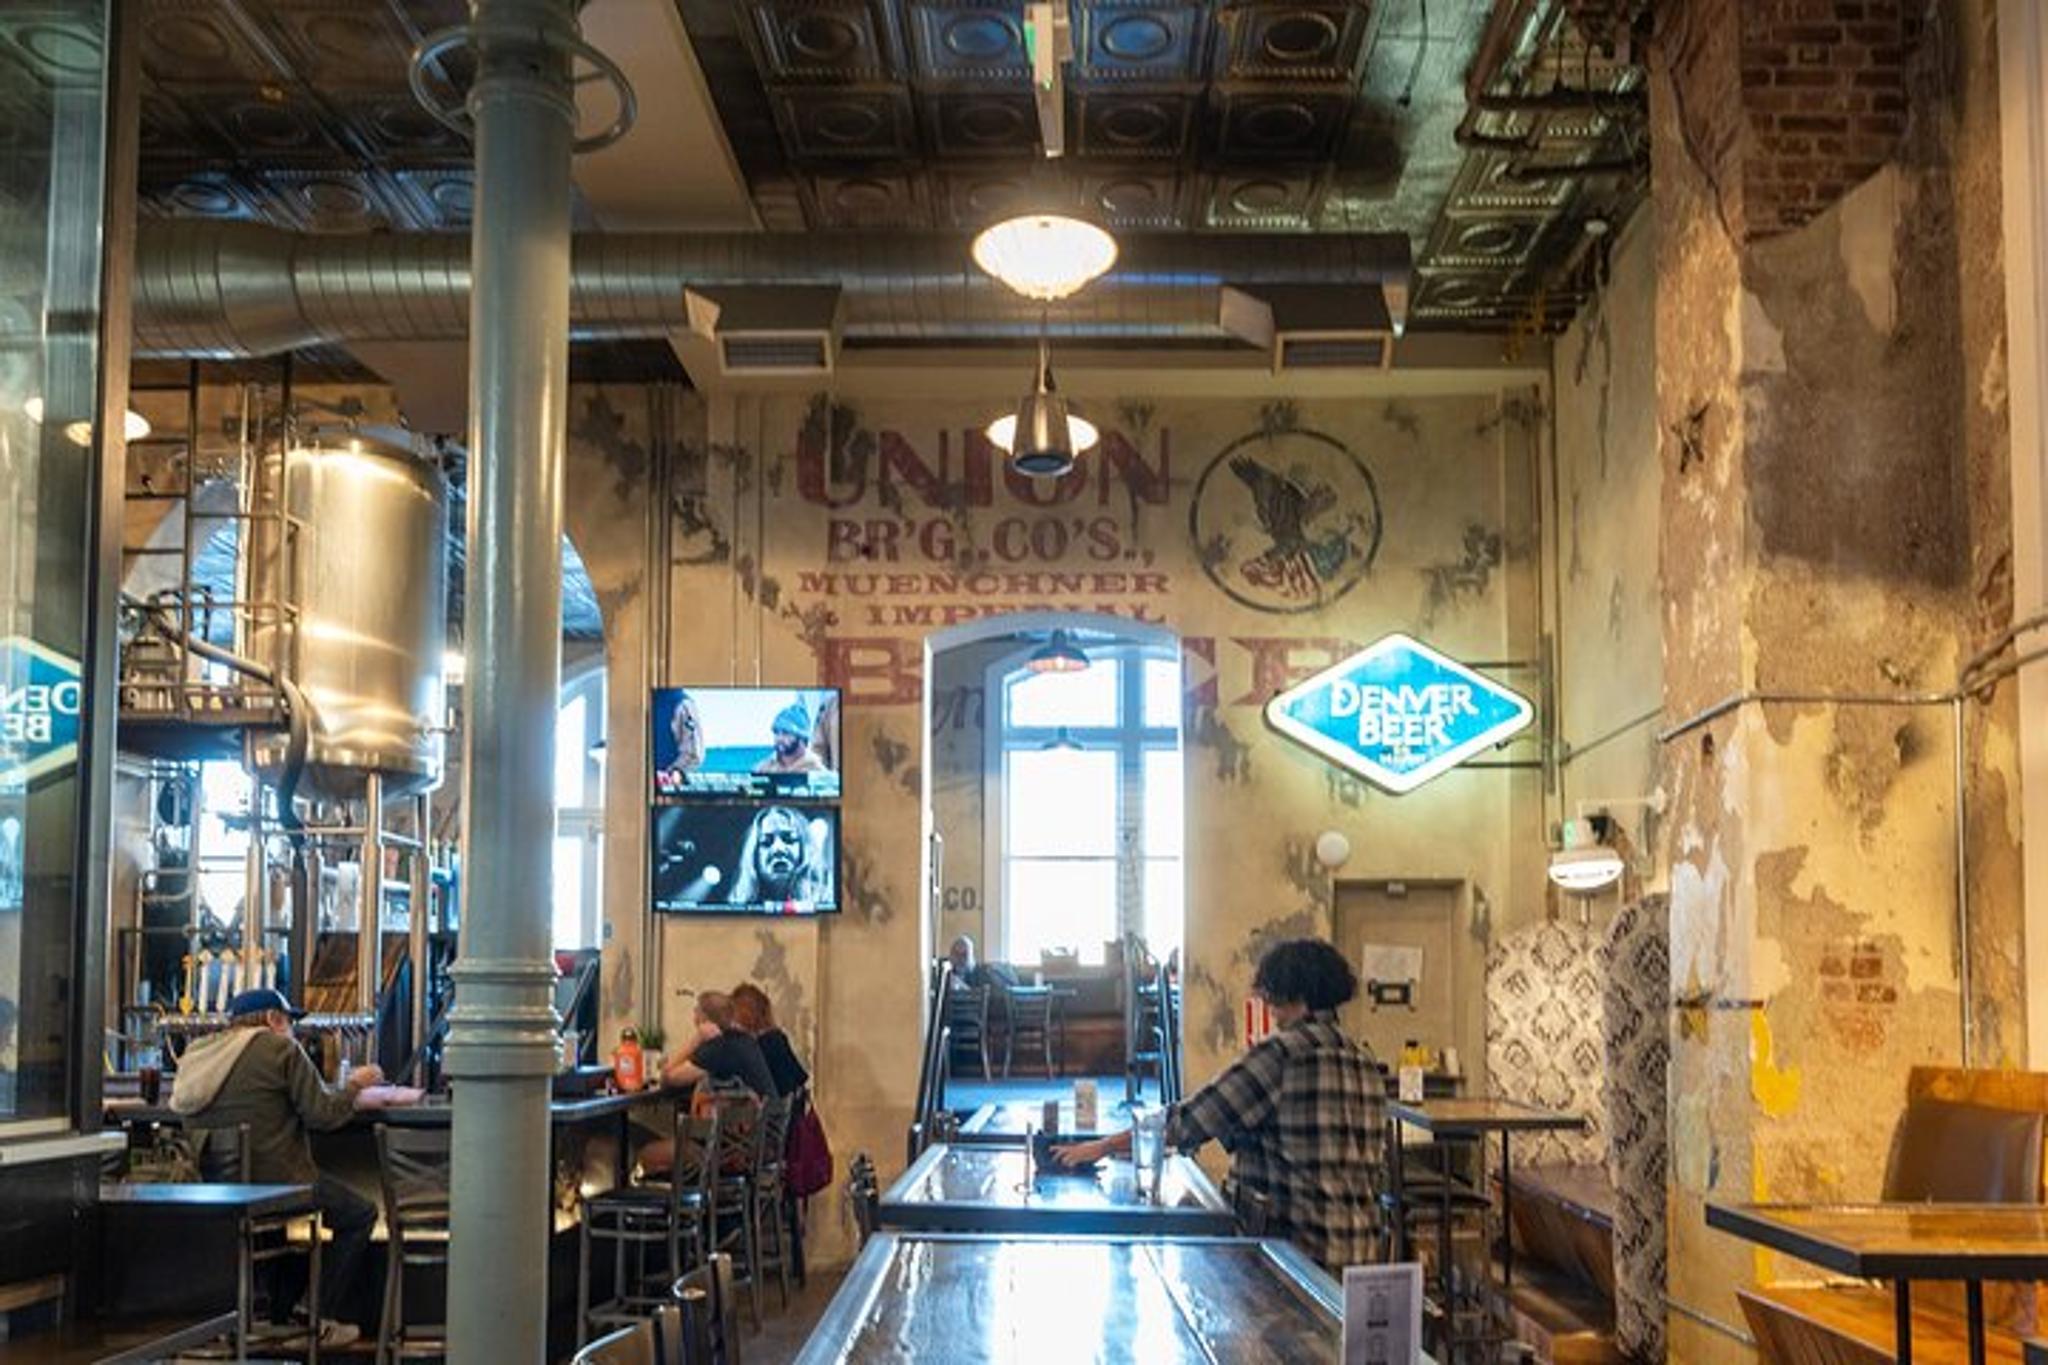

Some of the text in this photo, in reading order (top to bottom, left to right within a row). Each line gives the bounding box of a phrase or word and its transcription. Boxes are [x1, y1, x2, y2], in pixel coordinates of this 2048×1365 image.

[798, 572, 1171, 596] MUENCHNER
[1330, 680, 1480, 717] DENVER
[1359, 713, 1454, 747] BEER
